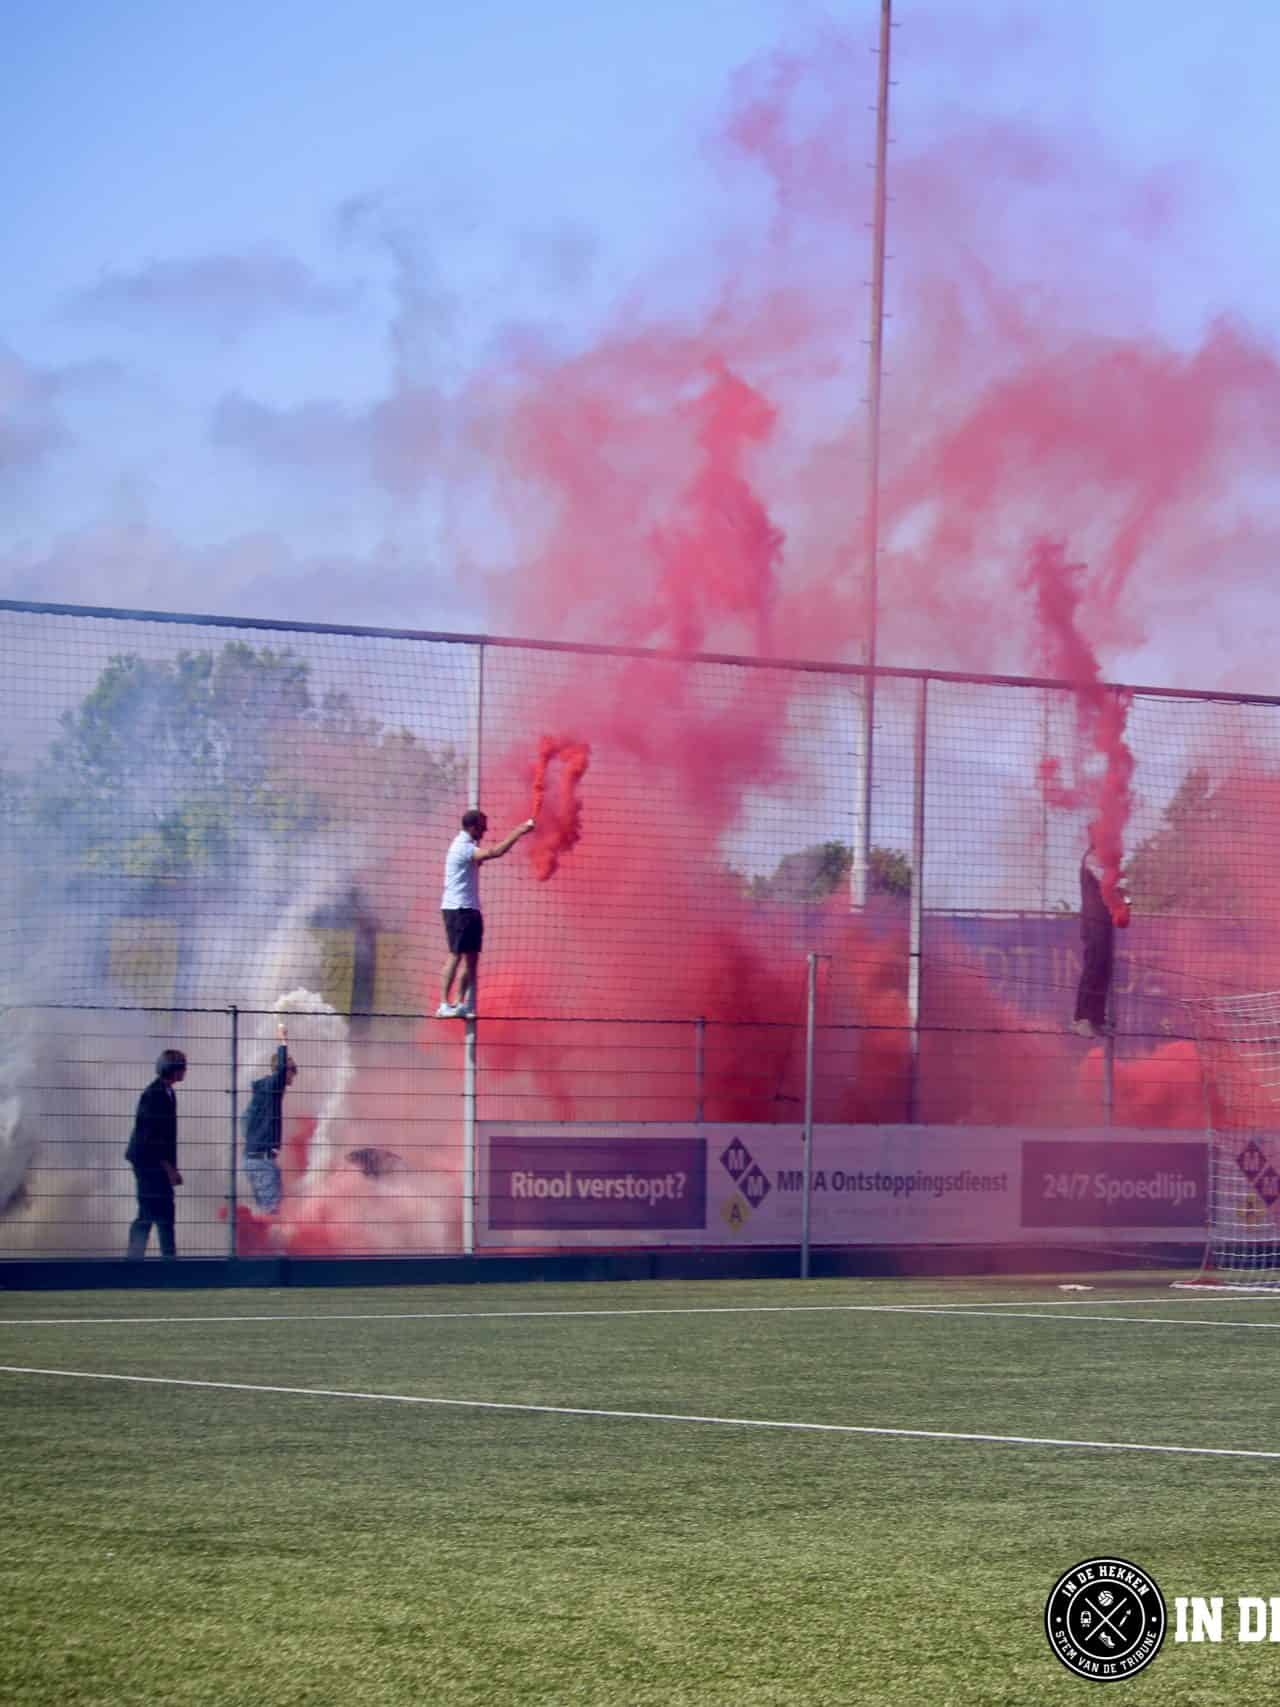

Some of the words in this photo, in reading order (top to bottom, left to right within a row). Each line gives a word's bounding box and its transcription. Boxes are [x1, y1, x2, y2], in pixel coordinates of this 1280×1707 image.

[510, 1171, 571, 1198] Riool
[576, 1172, 687, 1206] verstopt?
[831, 1170, 1009, 1199] Ontstoppingsdienst
[1042, 1173, 1090, 1201] 24/7
[1094, 1173, 1198, 1207] Spoedlijn
